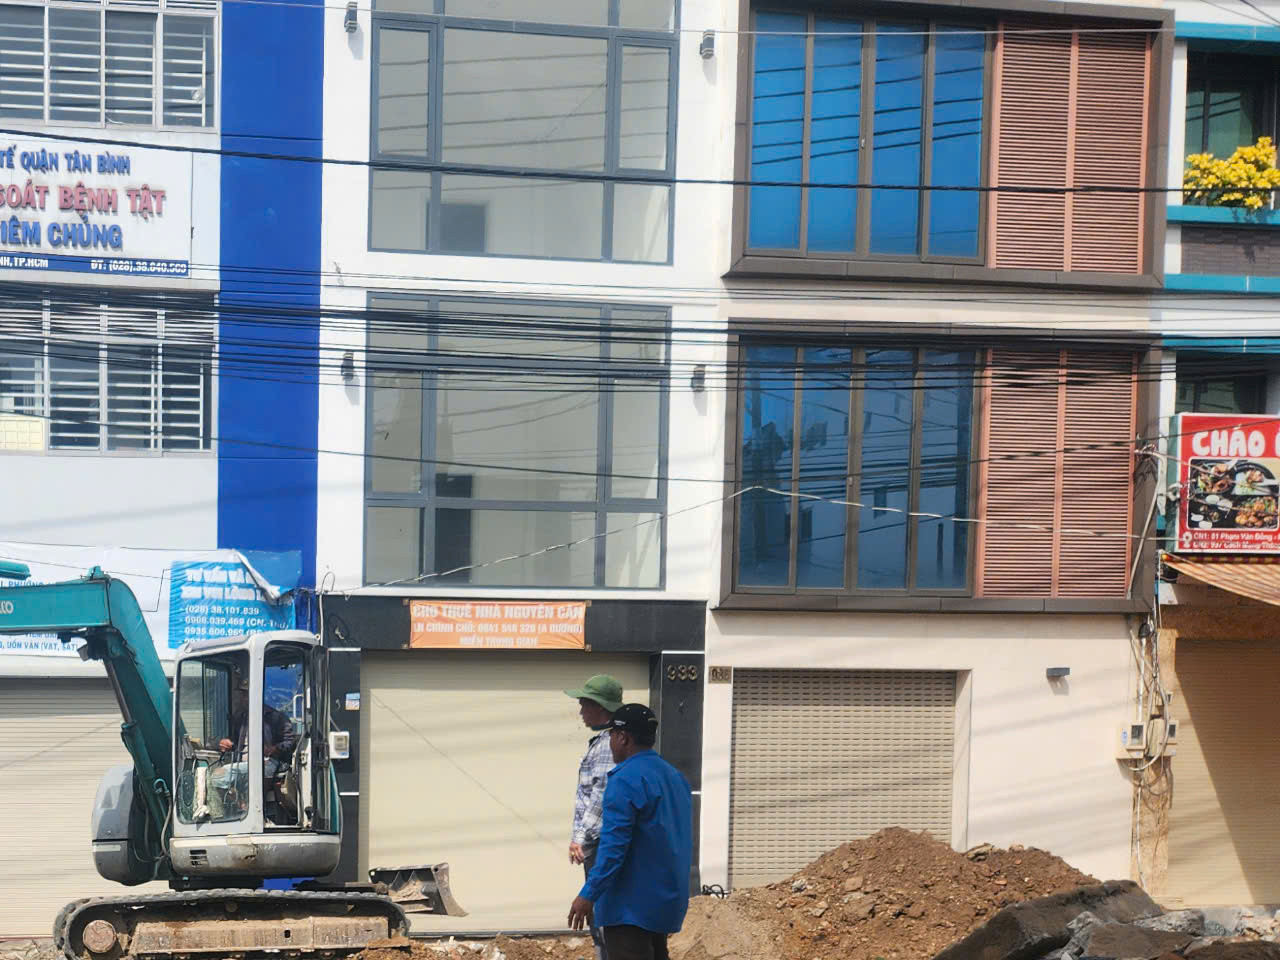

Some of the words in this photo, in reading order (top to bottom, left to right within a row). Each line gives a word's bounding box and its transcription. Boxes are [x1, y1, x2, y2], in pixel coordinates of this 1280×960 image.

[20, 148, 59, 174] QUẬN
[64, 150, 92, 174] TÂN
[97, 151, 130, 175] BÌNH
[58, 181, 118, 215] BỆNH
[126, 184, 166, 221] TẬT
[47, 214, 123, 249] CHỦNG
[1191, 424, 1266, 457] CHÁO
